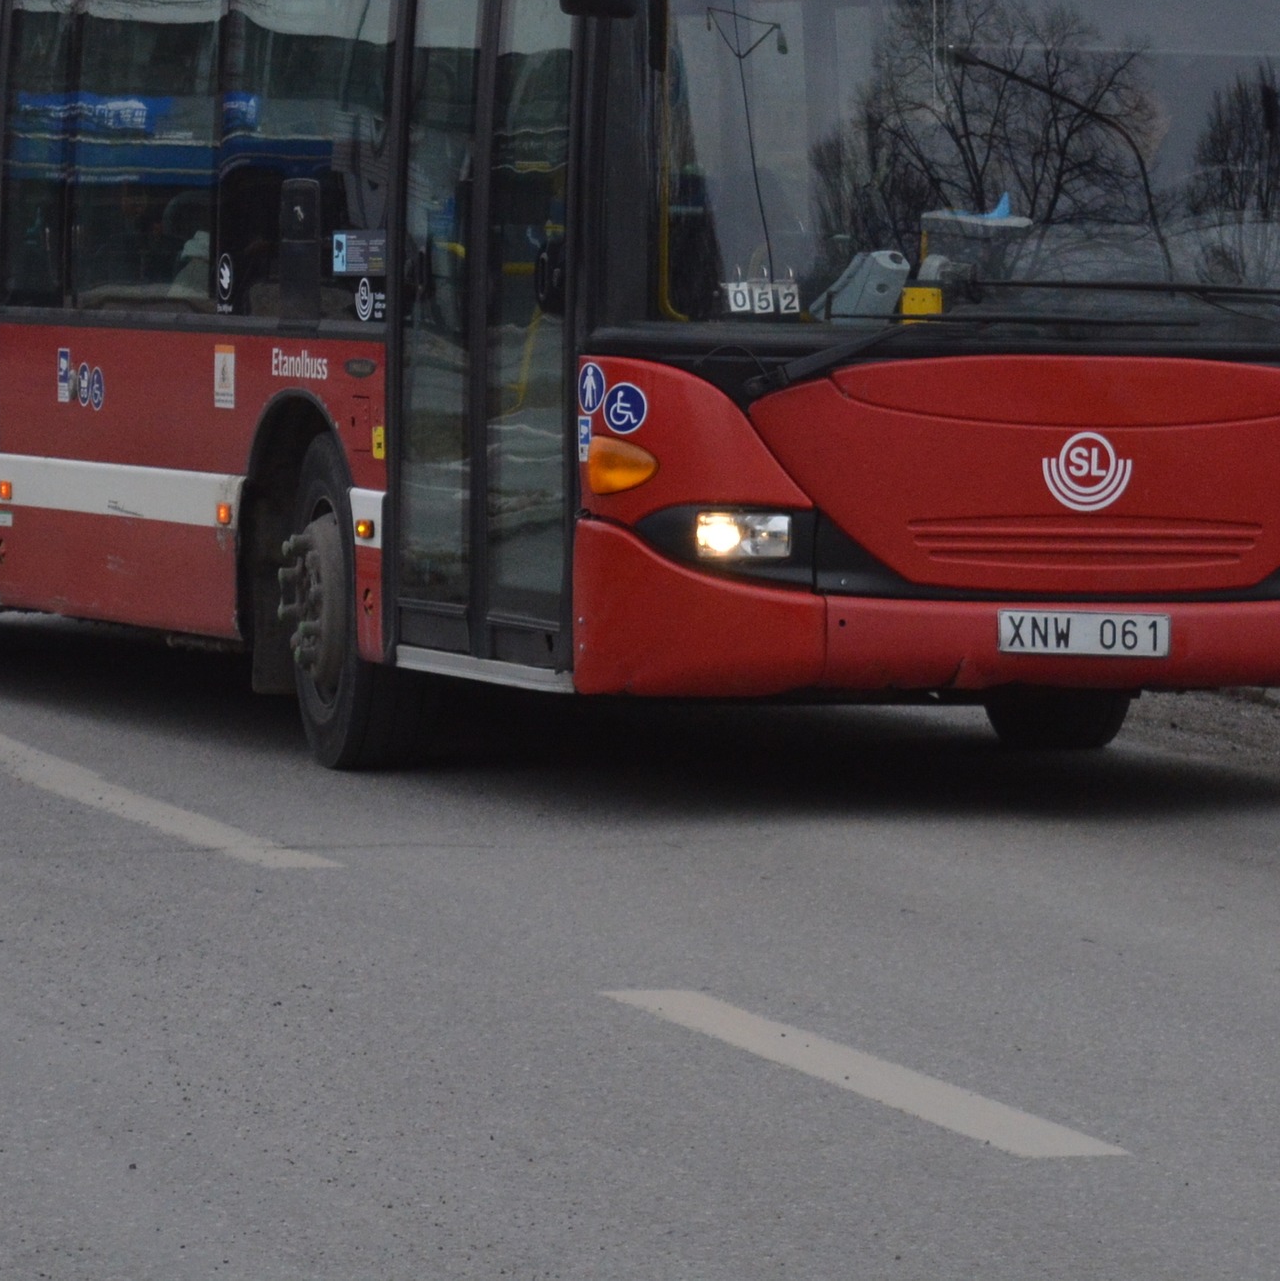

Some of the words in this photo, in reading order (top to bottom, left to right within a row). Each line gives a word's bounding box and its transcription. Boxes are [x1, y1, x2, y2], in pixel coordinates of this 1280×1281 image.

[732, 289, 797, 311] 052
[271, 347, 329, 380] Etanolbuss
[1068, 446, 1107, 477] SL
[1007, 615, 1072, 649] XNW
[1098, 618, 1160, 652] 061
